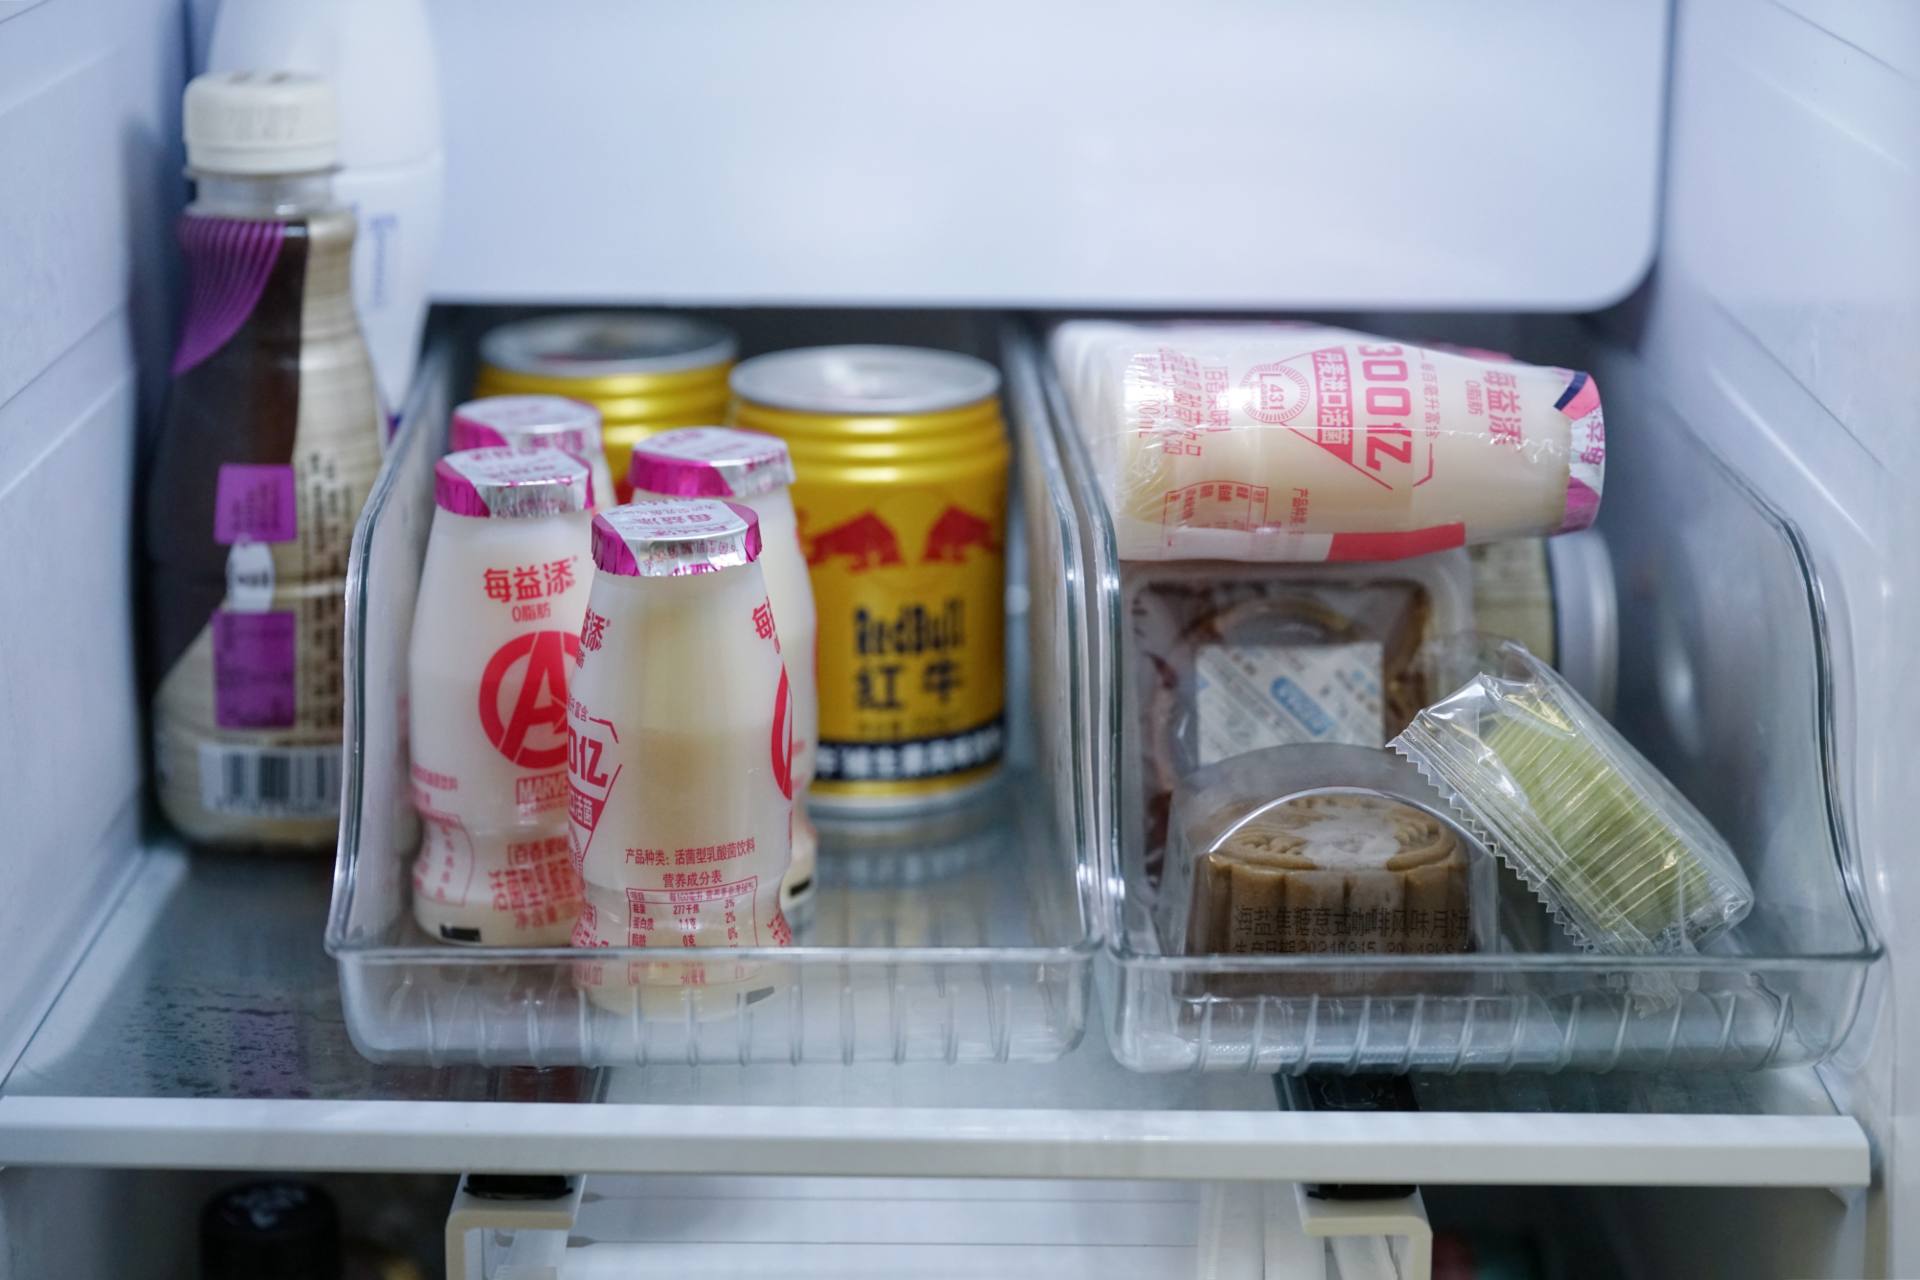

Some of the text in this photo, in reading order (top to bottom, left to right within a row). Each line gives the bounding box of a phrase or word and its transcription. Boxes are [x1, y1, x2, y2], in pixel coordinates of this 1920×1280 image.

[1357, 344, 1412, 472] 300亿
[482, 558, 575, 604] 每益添
[512, 602, 553, 623] 0脂肪
[663, 869, 723, 889] 营养成分表
